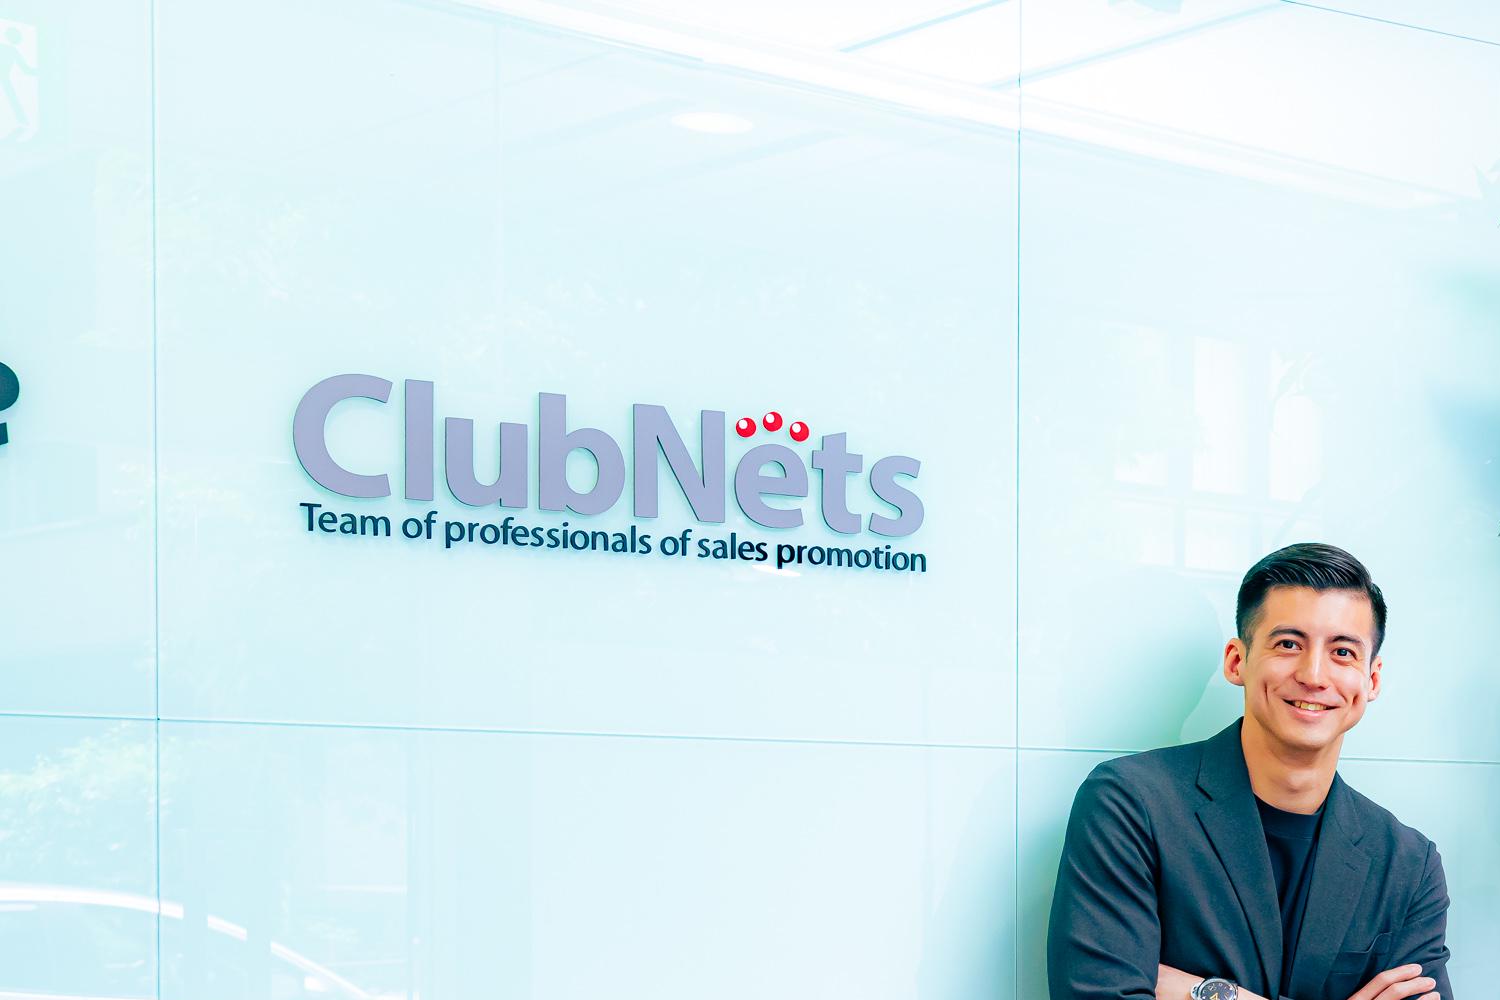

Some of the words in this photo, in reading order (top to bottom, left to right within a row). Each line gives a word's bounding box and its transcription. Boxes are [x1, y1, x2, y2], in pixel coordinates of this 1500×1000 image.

[293, 373, 925, 537] ClubNets
[300, 502, 391, 537] Team
[402, 510, 438, 540] of
[445, 516, 652, 555] professionals
[659, 529, 693, 557] of
[697, 533, 768, 562] sales
[777, 543, 927, 573] promotion
